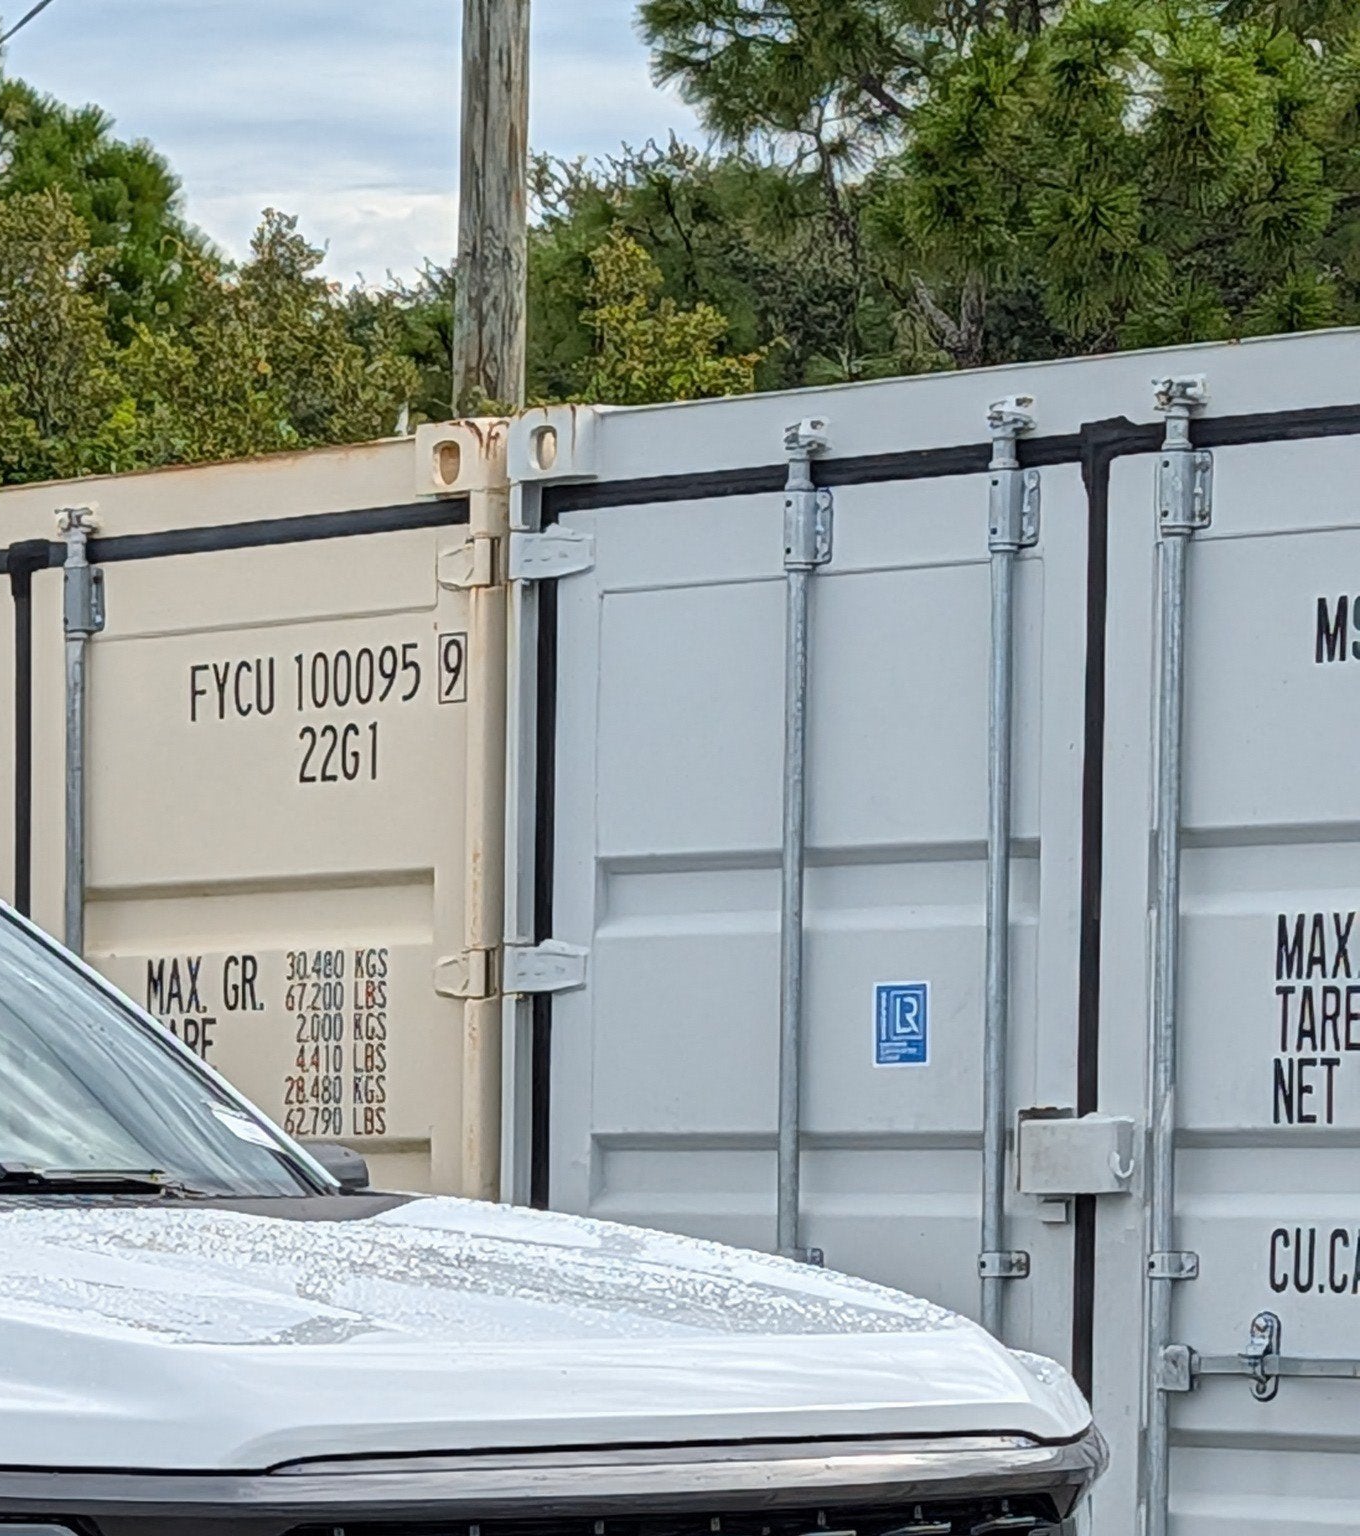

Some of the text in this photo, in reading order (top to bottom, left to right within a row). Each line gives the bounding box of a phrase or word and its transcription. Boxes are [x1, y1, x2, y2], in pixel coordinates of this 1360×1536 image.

[191, 639, 463, 722] FYCU 100095 9
[299, 721, 378, 783] 22G1
[286, 948, 388, 981] 30.480 KGS
[147, 954, 264, 1015] MAX. GR.
[285, 980, 387, 1011] 67.200 LBS
[296, 1011, 387, 1043] 2.000 KGS
[1275, 985, 1360, 1052] TARE
[296, 1042, 387, 1074] 4.410 LBS
[284, 1074, 386, 1105] 28.480 KGS
[1273, 1057, 1341, 1125] NET
[353, 1106, 386, 1136] LBS
